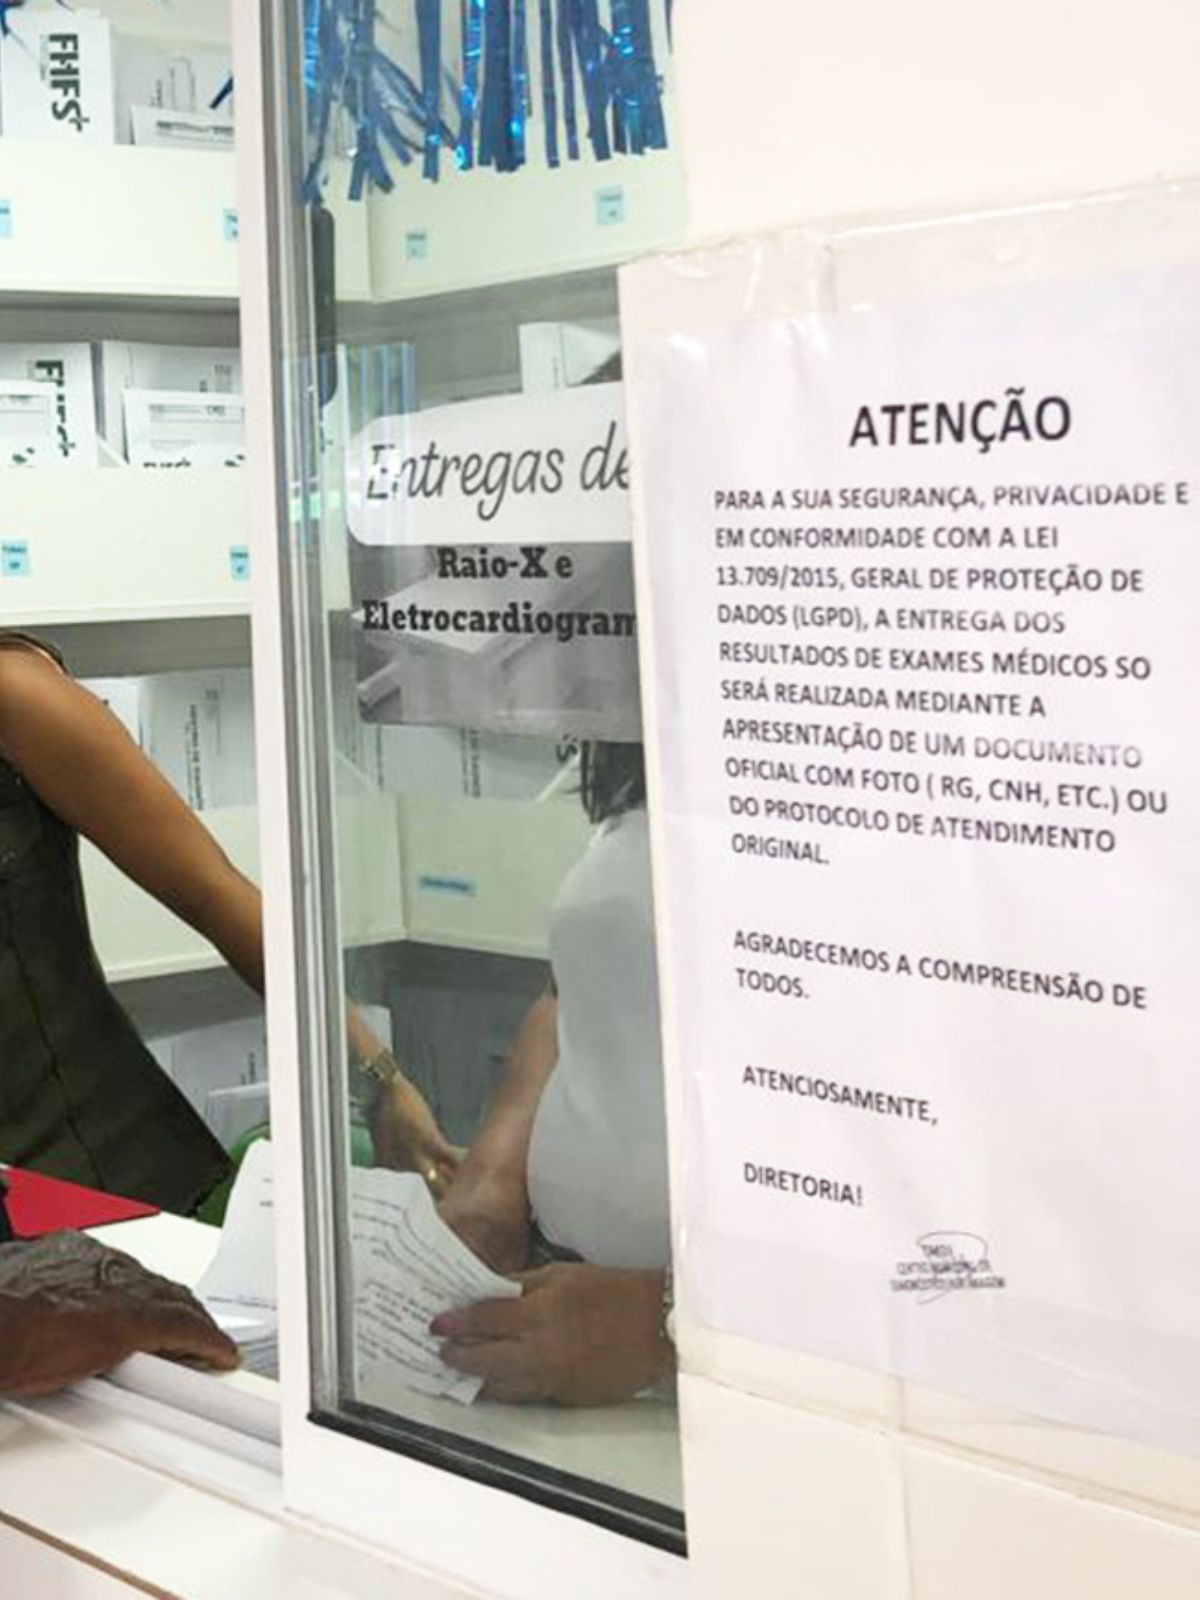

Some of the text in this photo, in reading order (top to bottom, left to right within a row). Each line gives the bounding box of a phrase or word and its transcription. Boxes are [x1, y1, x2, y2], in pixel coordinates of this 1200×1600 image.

[849, 387, 1071, 454] ATENÇÃO
[368, 441, 564, 521] Entregas
[715, 482, 1188, 512] PARA A SUA SEGURANÇA, PRIVACIDADE E
[716, 526, 1058, 549] EM CONFORMIDADE COM A LEI
[437, 547, 573, 578] Raio-X e
[851, 567, 923, 589] GERAL
[929, 568, 958, 590] DE
[967, 563, 1103, 596] PROTEÇÃO
[1111, 569, 1142, 592] DE
[717, 604, 1066, 634] DADOS (LGPD), A ENTREGA DOS
[719, 641, 1151, 680] RESULTADOS DE EXAMES MÉDICOS SO
[721, 678, 1046, 717] SERÁ REALIZADA MEDIANTE A
[723, 718, 1142, 769] APRESENTAÇÃO DE UM DOCUMENTO
[725, 757, 800, 784] OFICIAL
[804, 764, 854, 787] COM
[861, 769, 920, 794] FOTO
[941, 775, 981, 803] RG,
[989, 778, 1049, 807] CNH,
[1057, 783, 1119, 815] ETC.)
[1126, 789, 1168, 814] OU
[729, 795, 1116, 853] DO PROTOCOLO DE ATENDIMENTO
[731, 833, 829, 864] ORIGINAL.
[734, 930, 1146, 1009] AGRADECEMOS A COMPREENSÃO DE
[736, 967, 809, 999] TODOS.
[742, 1065, 937, 1126] ATENCIOSAMENTE,
[744, 1162, 862, 1206] DIRETORIA!
